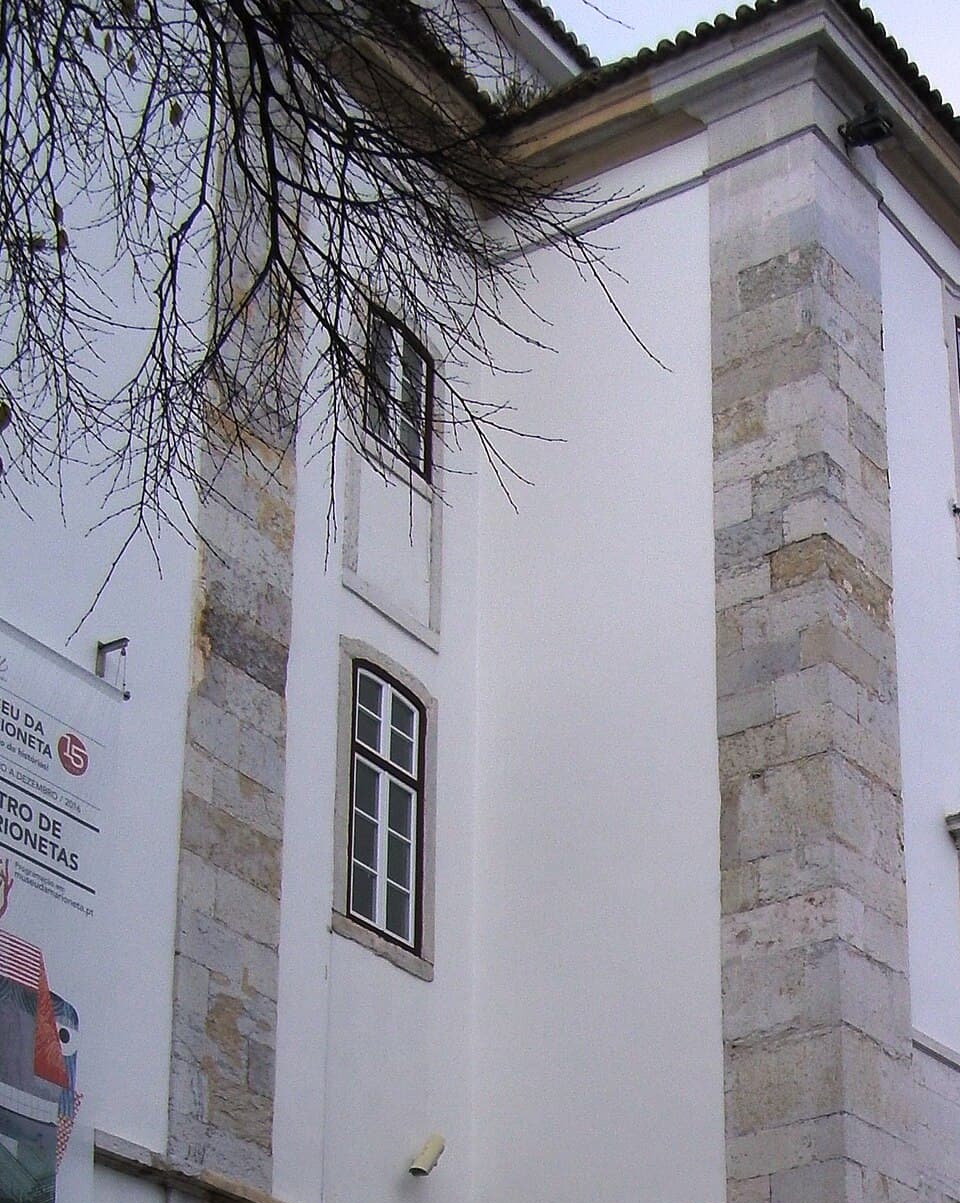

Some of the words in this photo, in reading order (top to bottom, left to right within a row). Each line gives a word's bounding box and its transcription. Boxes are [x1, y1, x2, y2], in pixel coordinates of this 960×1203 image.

[0, 698, 20, 721] EU
[24, 713, 44, 736] DA
[62, 734, 88, 769] 15
[9, 768, 15, 777] A
[16, 771, 57, 801] DEZEMBRO
[39, 812, 62, 839] DE
